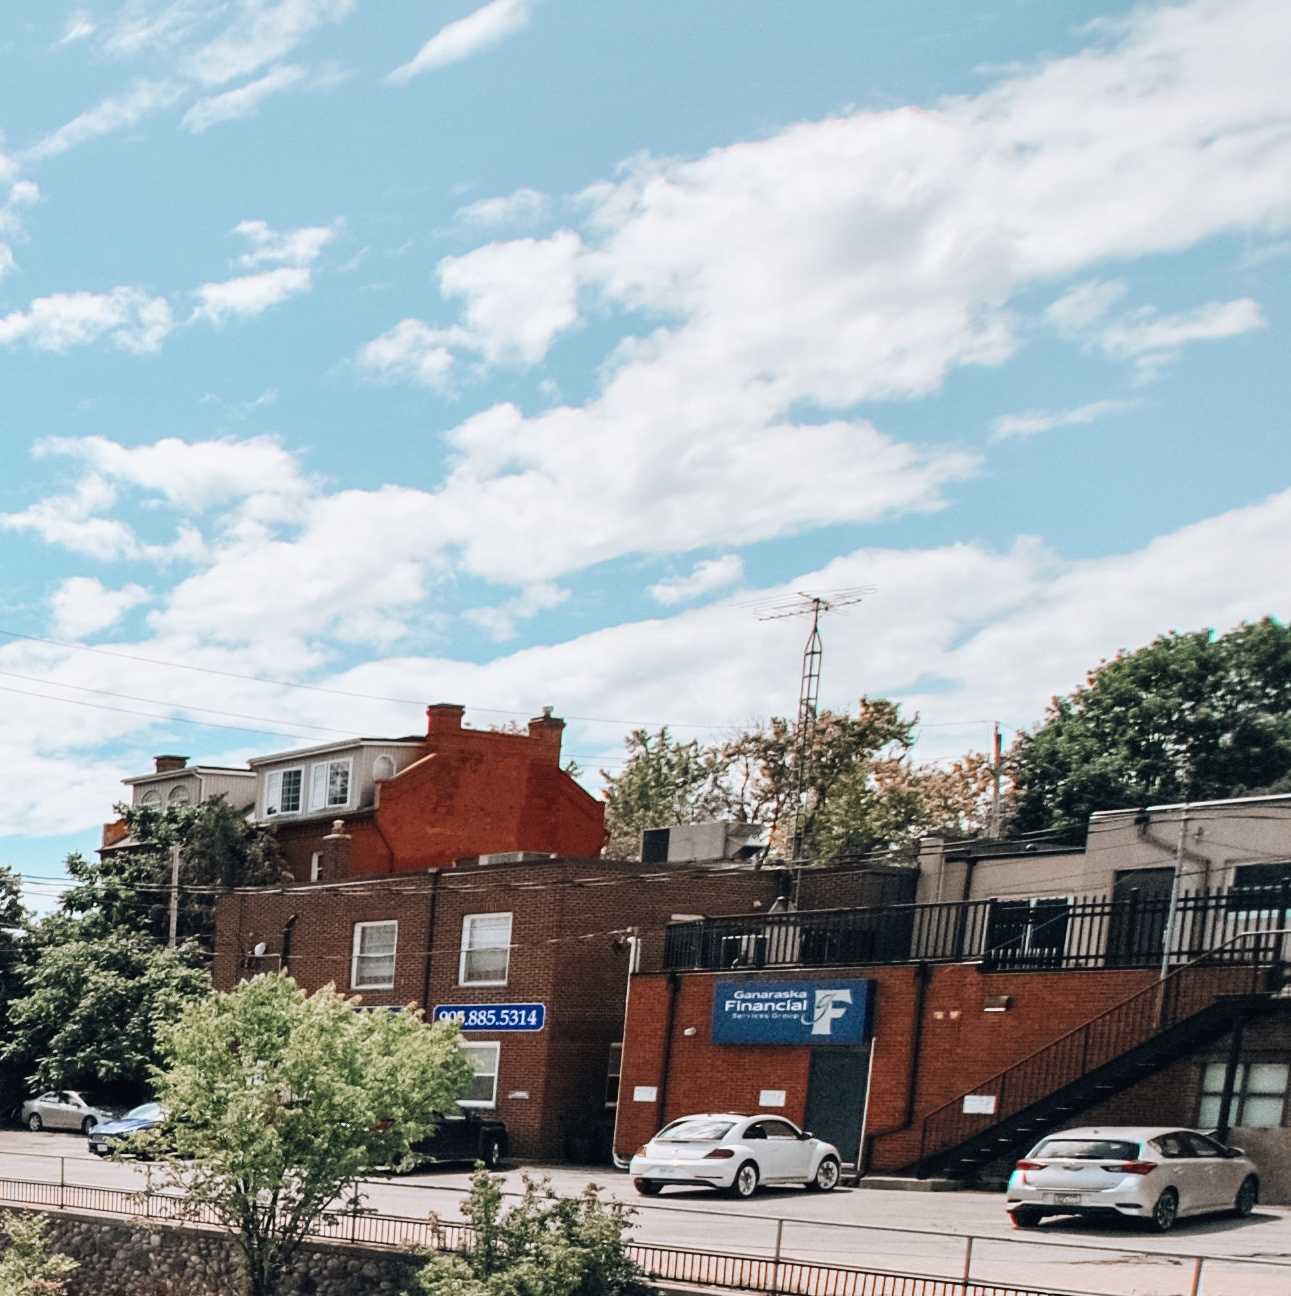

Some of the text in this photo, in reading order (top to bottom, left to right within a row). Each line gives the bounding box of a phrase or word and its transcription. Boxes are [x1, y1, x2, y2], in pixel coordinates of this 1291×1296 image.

[733, 990, 808, 1000] Ganaraska
[724, 1000, 808, 1012] Financial
[439, 1009, 537, 1026] 905.885.5314
